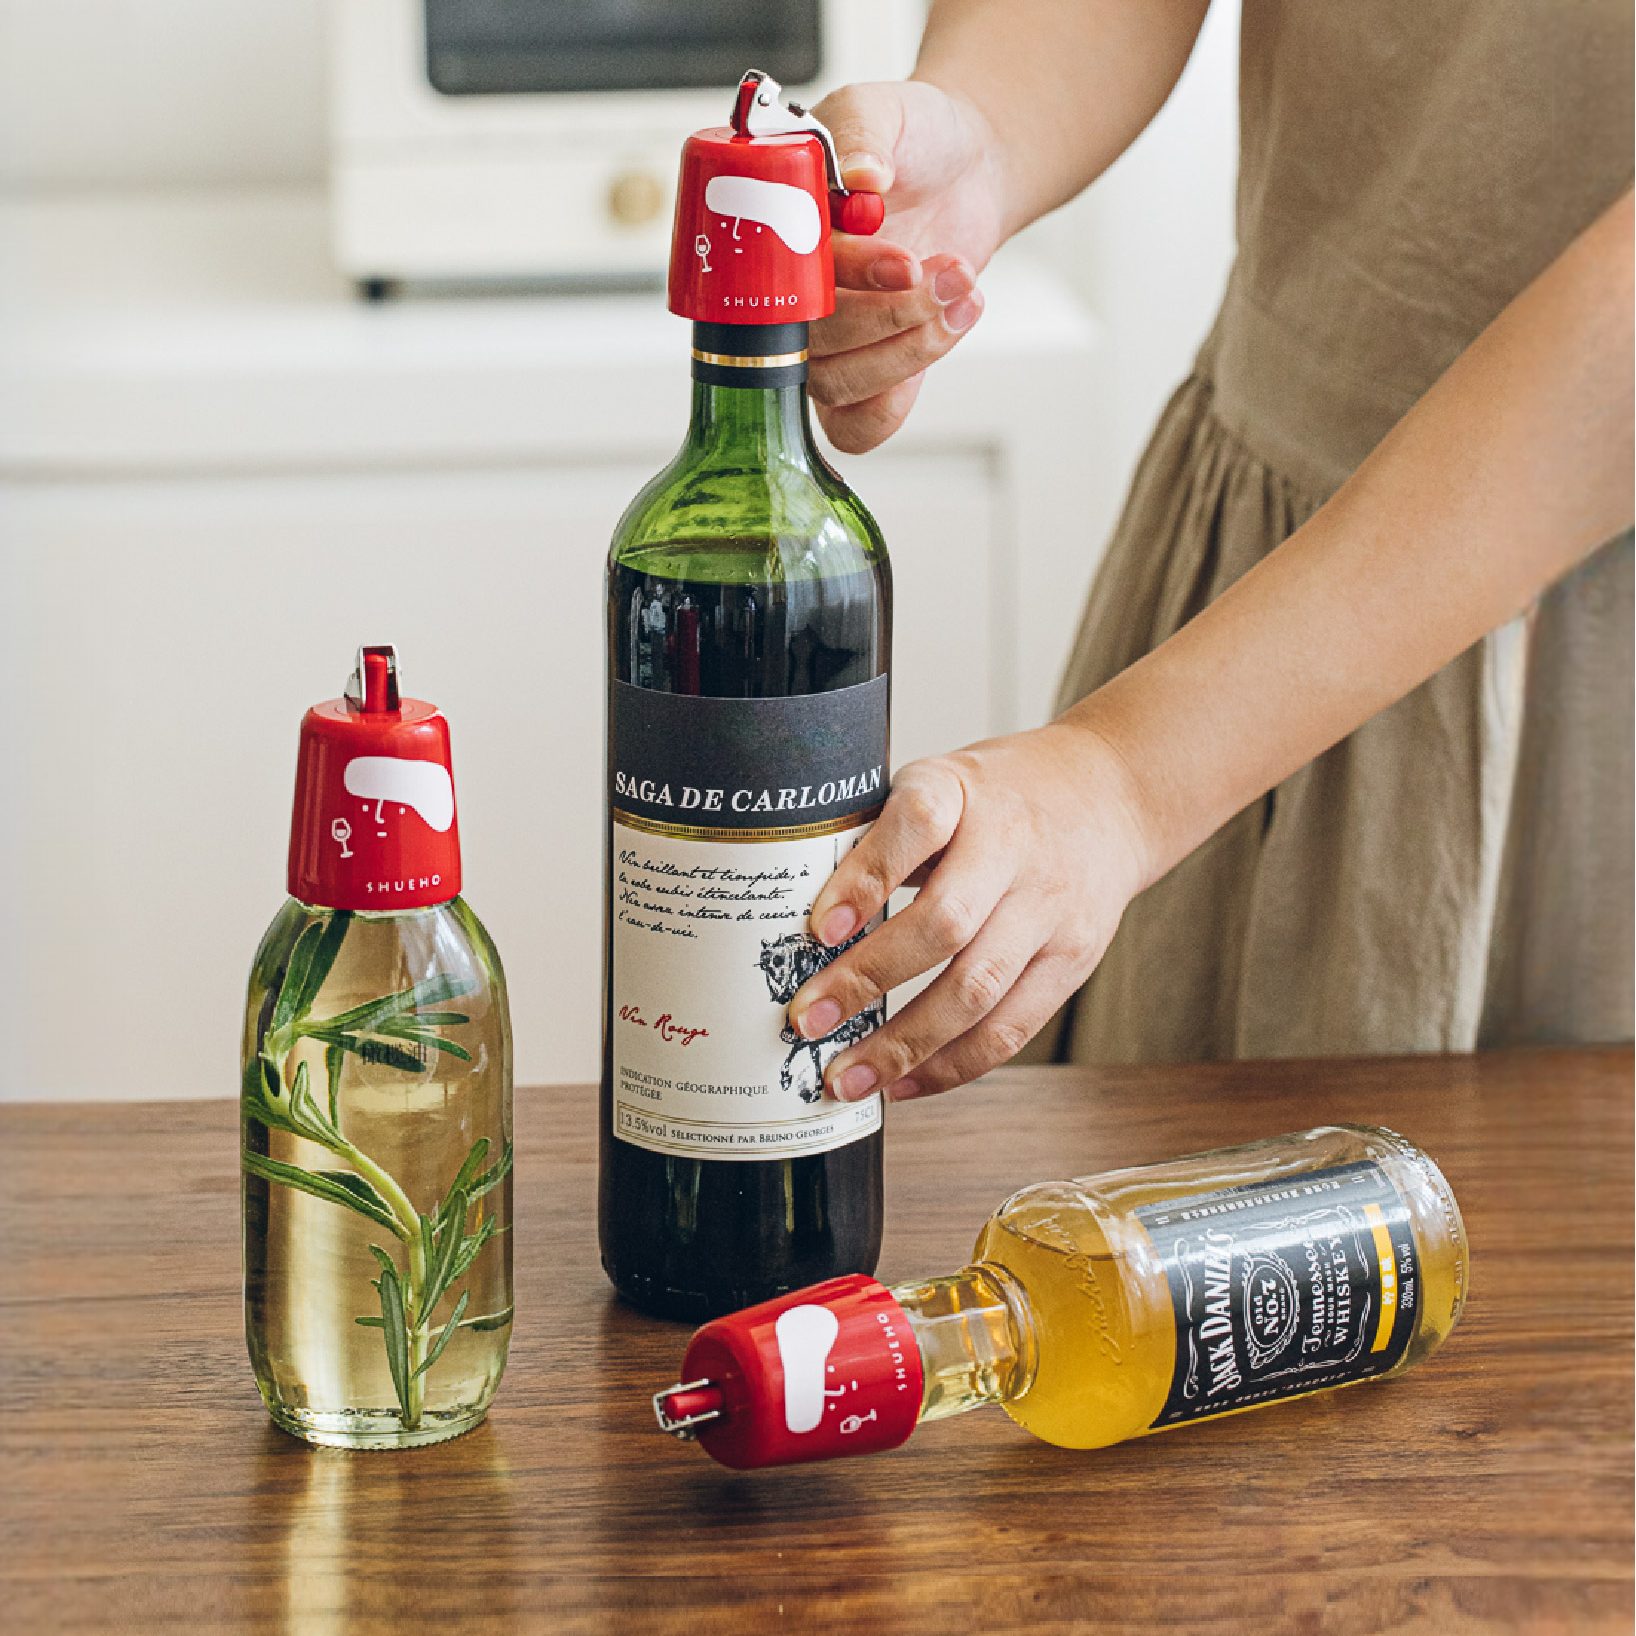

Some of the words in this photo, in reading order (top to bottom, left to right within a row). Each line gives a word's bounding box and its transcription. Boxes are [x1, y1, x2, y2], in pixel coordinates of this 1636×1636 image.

[723, 294, 798, 307] SHUEHO
[613, 770, 675, 806] SAGA
[678, 786, 725, 811] DE
[730, 764, 882, 812] CARLOMAN
[619, 850, 641, 868] Vin
[366, 874, 441, 893] SHUEHO
[619, 1004, 648, 1026] Vin
[653, 1013, 709, 1047] Rouge
[620, 1065, 672, 1089] INDICATION
[675, 1080, 770, 1098] GÉOGRAPHIQUE
[619, 1111, 667, 1138] 13.5%vol
[738, 1133, 757, 1144] PAR
[759, 1132, 793, 1144] BRUNO
[1329, 1236, 1352, 1346] WHISKEY
[876, 1312, 908, 1392] SHUEHO
[1206, 1334, 1242, 1397] JACK
